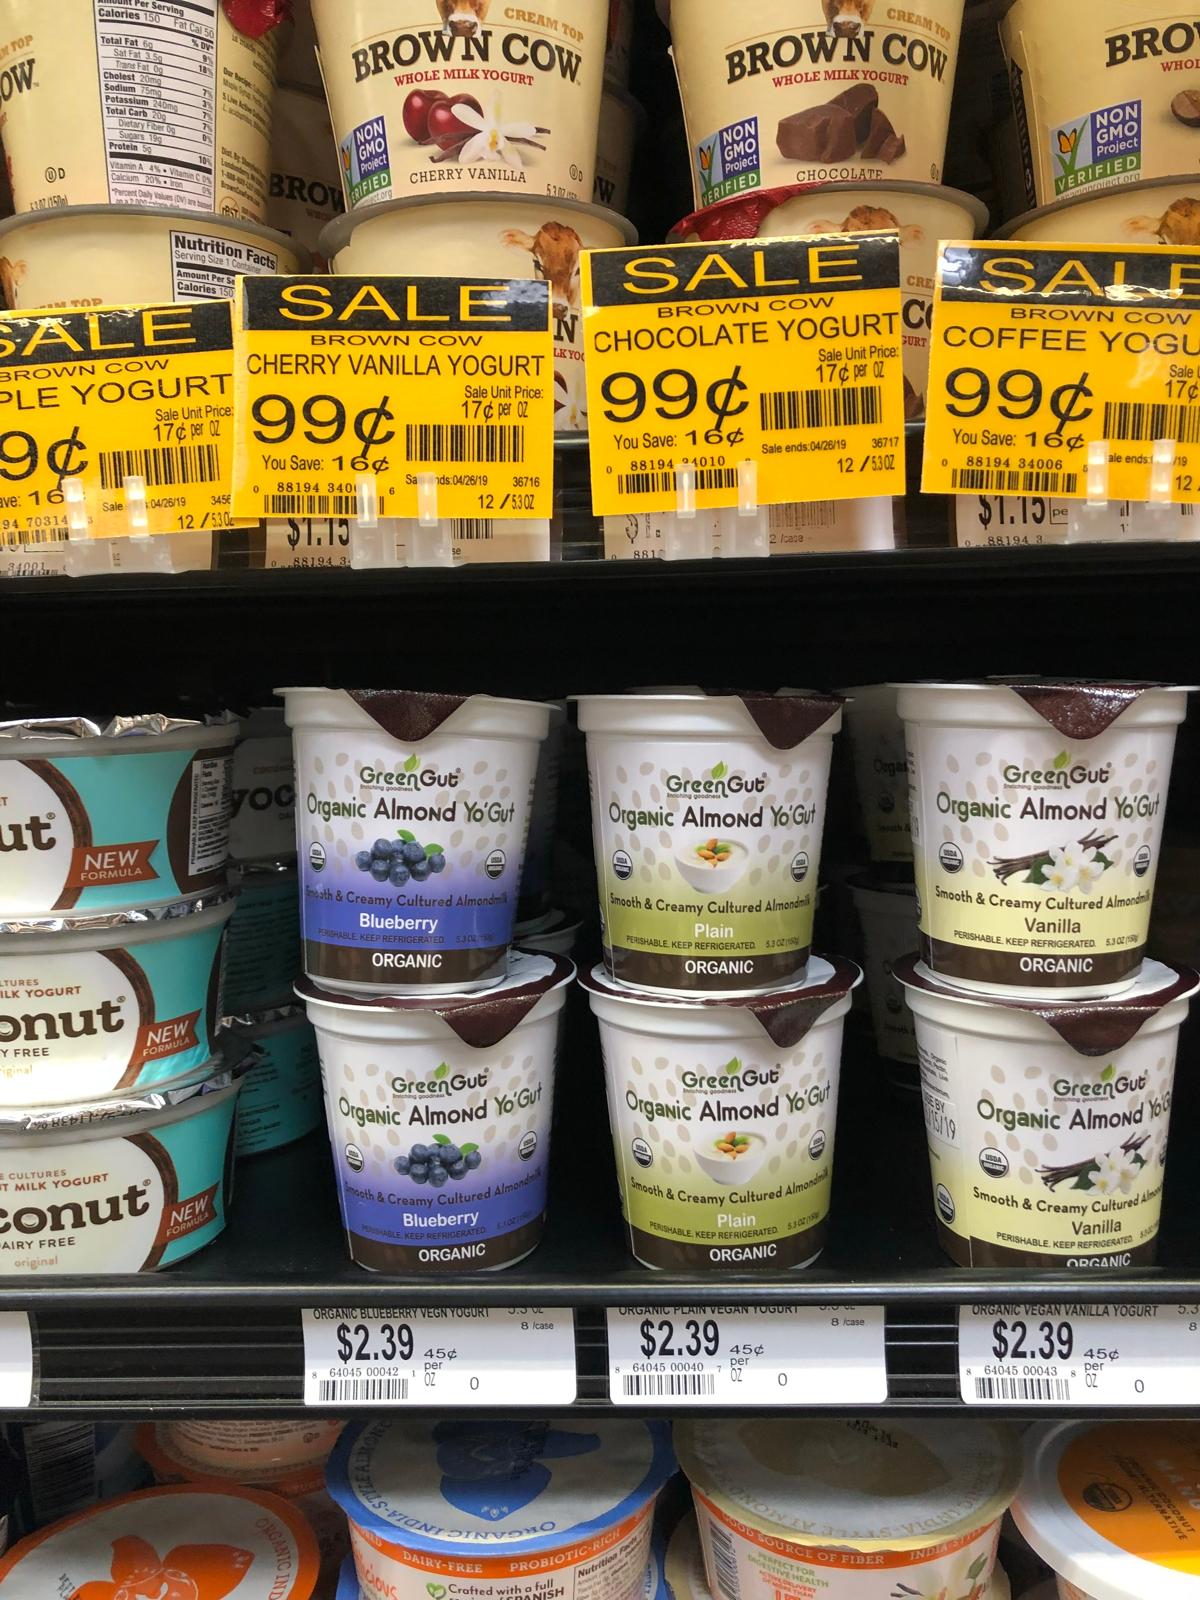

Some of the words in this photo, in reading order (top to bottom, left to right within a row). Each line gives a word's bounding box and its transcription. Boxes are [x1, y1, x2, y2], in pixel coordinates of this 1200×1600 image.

[98, 8, 140, 20] Calories
[886, 7, 932, 32] CREAM
[504, 7, 558, 31] CREAM
[561, 20, 584, 43] TOP
[101, 36, 122, 45] Total
[125, 38, 138, 46] Fat
[351, 30, 492, 83] BROWN
[501, 32, 582, 84] COW
[725, 31, 875, 84] BROWN
[882, 33, 948, 82] COW
[103, 71, 135, 81] Cholest
[393, 70, 440, 87] WHOLE
[444, 69, 480, 80] MILK
[482, 69, 534, 86] YOGURT
[772, 71, 820, 88] WHOLE
[823, 70, 860, 81] MILK
[862, 70, 909, 86] YOGURT
[104, 83, 136, 93] Sodium
[1096, 103, 1138, 128] NON
[356, 119, 383, 145] NON
[722, 121, 756, 145] NON
[1096, 121, 1138, 143] GMO
[109, 142, 138, 151] Protein
[359, 137, 385, 161] GMO
[724, 140, 756, 161] GMO
[1096, 138, 1138, 157] Project
[360, 153, 387, 174] Project
[725, 154, 758, 175] Project
[1057, 156, 1137, 191] VERIFIED
[409, 168, 463, 185] CHERRY
[470, 168, 527, 183] VANILLA
[796, 169, 883, 182] CHOCOLATE
[174, 234, 242, 259] Nutrition
[246, 249, 276, 270] Facts
[174, 250, 206, 265] Serving
[208, 255, 224, 266] Size
[622, 243, 863, 294] SALE
[177, 281, 217, 294] Calories
[278, 284, 512, 322] SALE
[657, 300, 759, 318] BROWN
[768, 296, 834, 312] COW
[1010, 307, 1114, 323] BROWN
[1124, 311, 1192, 325] COW
[311, 334, 410, 346] BROWN
[419, 335, 483, 347] COW
[594, 321, 769, 353] CHOCOLATE
[777, 312, 899, 340] YOGURT
[943, 325, 1087, 351] COFFEE
[818, 347, 843, 362] Sale
[845, 346, 867, 360] Unit
[869, 344, 899, 359] Price:
[105, 359, 169, 374] COW
[247, 353, 342, 376] CHERRY
[348, 354, 441, 376] VANILLA
[447, 355, 545, 377] YOGURT
[71, 373, 233, 406] YOGURT
[465, 385, 488, 399] Sale
[491, 385, 512, 399] Unit
[514, 386, 544, 399] Price:
[600, 364, 749, 431] 99¢
[816, 362, 849, 386] 17¢
[853, 363, 868, 381] per
[944, 366, 1093, 434] 99¢
[155, 407, 179, 422] Sale
[181, 405, 203, 420] Unit
[251, 393, 396, 459] 99¢
[460, 400, 494, 423] 17¢
[498, 401, 512, 419] per
[614, 434, 639, 450] You
[642, 432, 677, 448] Save:
[685, 430, 745, 448] 16¢
[761, 442, 783, 454] Sale
[871, 436, 899, 448] 36717
[953, 429, 977, 445] You
[981, 430, 1017, 447] Save:
[1024, 431, 1084, 452] 16¢
[261, 455, 288, 471] You
[290, 454, 324, 471] Save:
[331, 455, 390, 475] 16¢
[966, 456, 1010, 468] 88194
[1018, 457, 1062, 470] 34006
[277, 482, 319, 494] 88194
[512, 476, 540, 488] 36716
[359, 766, 460, 792] GreenGut
[666, 774, 765, 798] GreenGut
[1003, 764, 1109, 789] GreenGut
[464, 801, 515, 823] Yo'Gut
[770, 802, 816, 827] Yo'Gut
[84, 849, 139, 871] NEW
[80, 867, 143, 881] FORMULA
[610, 892, 642, 909] Smooth
[656, 899, 703, 916] Creamy
[707, 900, 762, 914] Cultured
[935, 885, 973, 904] Smooth
[988, 894, 1041, 912] Creamy
[1046, 896, 1103, 910] Cultured
[359, 912, 438, 934] Blueberry
[694, 923, 734, 939] Plain
[1024, 917, 1081, 934] Vanilla
[954, 929, 1004, 945] PERISHABLE.
[1005, 936, 1029, 946] KEEP
[1030, 938, 1096, 948] REFRIGERATED.
[372, 953, 442, 968] ORGANIC
[684, 960, 754, 974] ORGANIC
[1019, 957, 1093, 973] ORGANIC
[27, 985, 82, 998] YOGURT
[146, 1019, 189, 1046] NEW
[14, 1047, 50, 1058] FREE
[143, 1036, 190, 1057] FORMULA
[391, 1073, 487, 1096] GreenGut
[681, 1068, 779, 1091] GreenGut
[1053, 1075, 1146, 1099] GreenGut
[630, 1176, 664, 1198] Smooth
[677, 1190, 725, 1207] Creamy
[729, 1186, 782, 1204] Cultured
[170, 1195, 208, 1226] NEW
[403, 1212, 479, 1228] Blueberry
[717, 1213, 756, 1229] Plain
[1071, 1220, 1122, 1235] Vanilla
[40, 1236, 76, 1248] FREE
[419, 1243, 486, 1262] ORGANIC
[709, 1243, 777, 1262] ORGANIC
[14, 1256, 58, 1270] original
[313, 1307, 357, 1320] ORGANIC
[360, 1307, 418, 1319] BLUEBERRY
[420, 1307, 447, 1318] VEGN
[449, 1307, 490, 1318] YOGURT
[972, 1305, 1021, 1316] ORGANIC
[1024, 1305, 1061, 1316] VEGAN
[1063, 1305, 1110, 1317] VANILLA
[1113, 1305, 1159, 1317] YOGURT
[336, 1322, 414, 1364] $2.39
[640, 1318, 720, 1359] $2.39
[992, 1319, 1074, 1362] $2.39
[424, 1348, 457, 1361] 45¢
[729, 1344, 764, 1357] 45¢
[1083, 1348, 1120, 1362] 45¢
[329, 1367, 362, 1377] 64045
[366, 1367, 399, 1377] 00042
[632, 1362, 666, 1373] 64045
[670, 1362, 704, 1372] 00040
[984, 1365, 1018, 1376] 64045
[1023, 1365, 1058, 1376] 00043
[509, 1528, 620, 1573] PROBIOTIC-RICH
[841, 1554, 885, 1565] FIBER
[402, 1551, 483, 1574] DAIRY-FREE
[578, 1550, 618, 1578] Nutrition
[448, 1583, 493, 1596] Crafted
[499, 1583, 523, 1596] with
